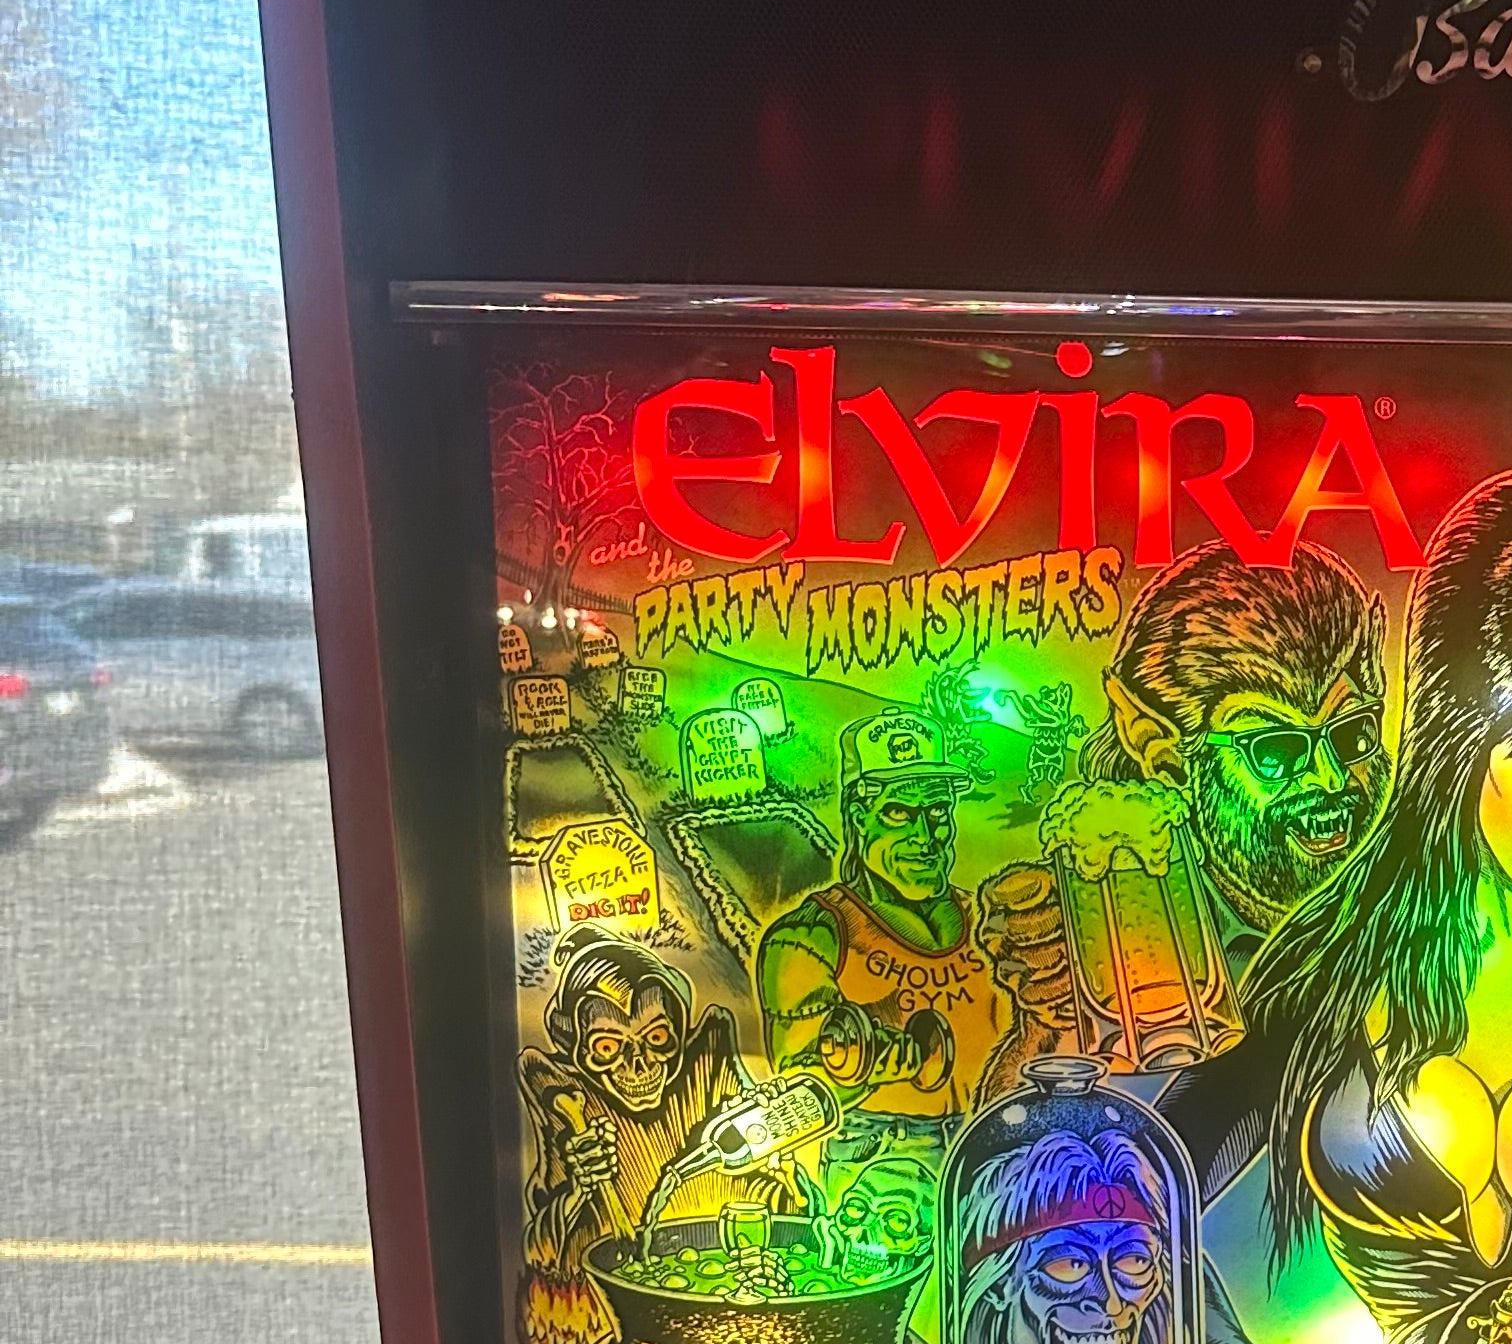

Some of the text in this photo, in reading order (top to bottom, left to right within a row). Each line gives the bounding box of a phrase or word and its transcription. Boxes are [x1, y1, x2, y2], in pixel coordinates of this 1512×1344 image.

[590, 521, 649, 566] and
[646, 548, 696, 583] the
[634, 544, 1124, 678] PARTY MONSTERS
[499, 649, 528, 664] TILT
[694, 717, 748, 739] VISIT
[707, 735, 738, 749] THE
[868, 717, 935, 744] GRAVESTONE
[694, 764, 759, 786] KICKER
[555, 826, 649, 881] GRAVESTONE
[565, 866, 629, 899] PIZZA
[568, 887, 651, 922] DIG IT!
[866, 949, 985, 989] GHOUL'S
[898, 987, 975, 1012] GYM
[773, 1099, 800, 1138] SHINE
[785, 1094, 813, 1131] CHATEAU
[800, 1092, 822, 1122] GLICK
[763, 1110, 785, 1139] MOON
